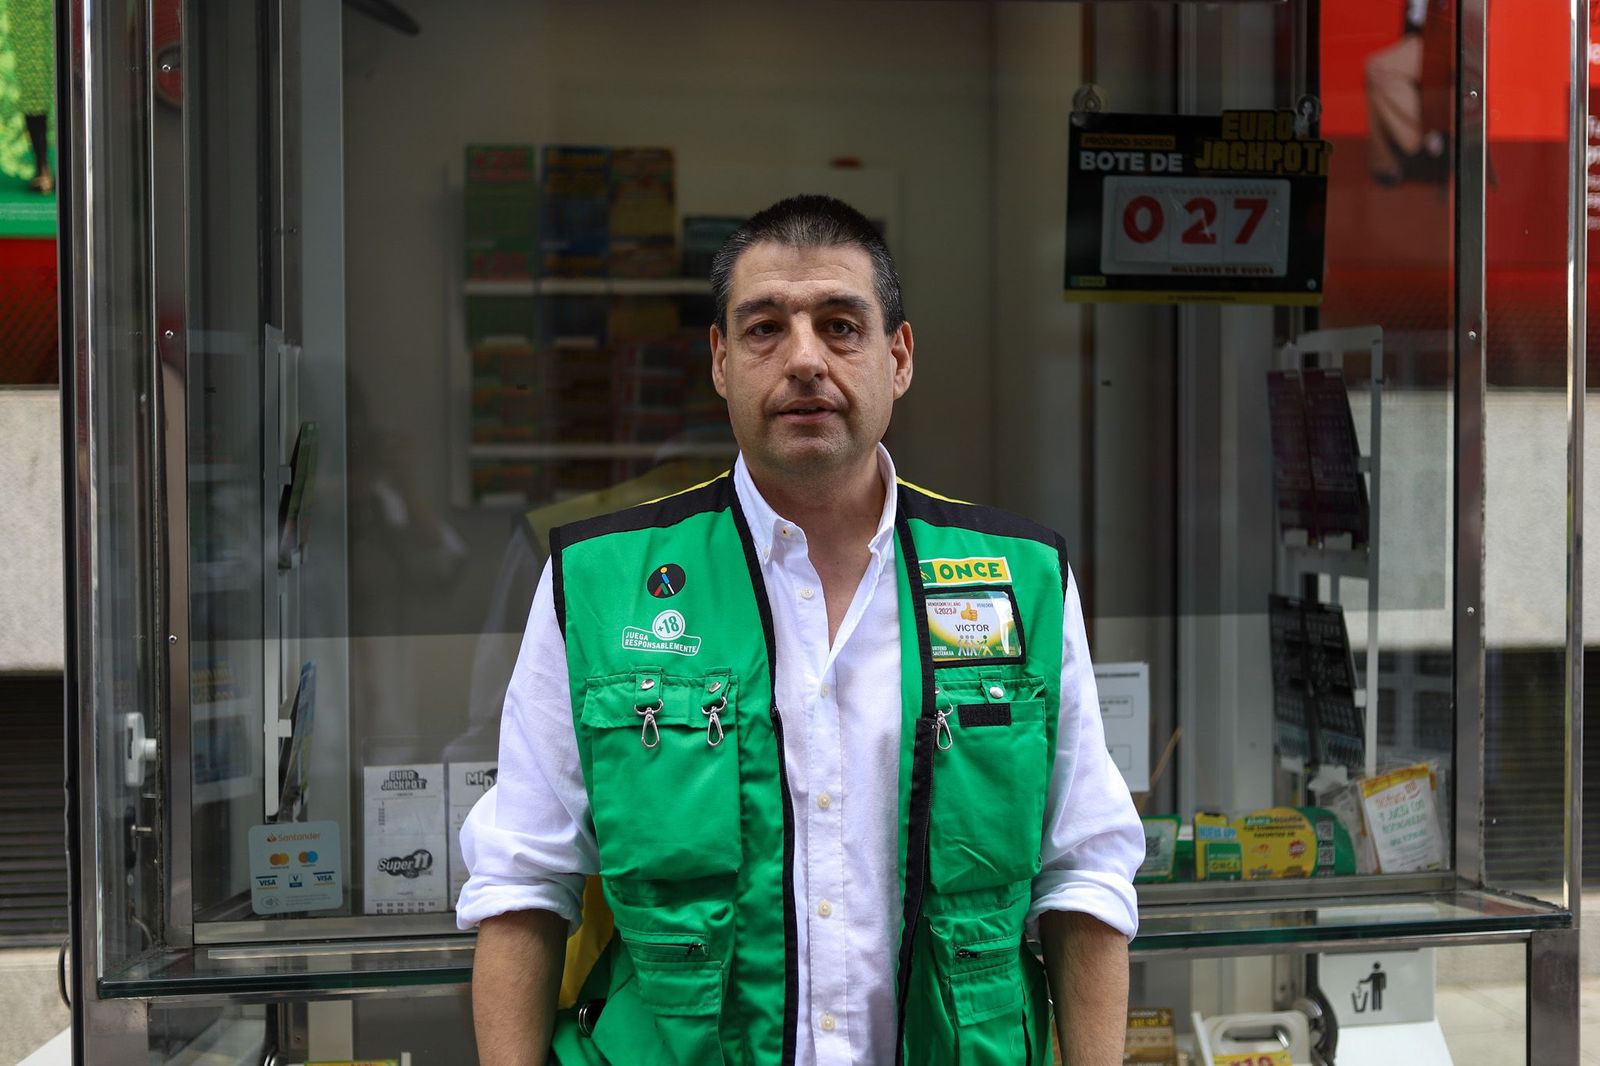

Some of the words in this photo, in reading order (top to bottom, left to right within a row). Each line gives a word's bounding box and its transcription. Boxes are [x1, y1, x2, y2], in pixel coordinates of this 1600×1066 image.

[1222, 112, 1294, 140] EURO
[1080, 151, 1146, 171] BOTE
[1150, 152, 1184, 173] DE
[1194, 141, 1322, 173] JACKPOT
[939, 562, 1003, 580] ONCE
[657, 615, 680, 634] +18
[955, 624, 990, 632] VICTOR
[625, 631, 648, 641] JUEGA
[624, 640, 698, 653] RESPONSABLEMENTE
[389, 770, 415, 781] EURO
[381, 780, 427, 791] JACKPOT
[278, 833, 320, 841] Santander
